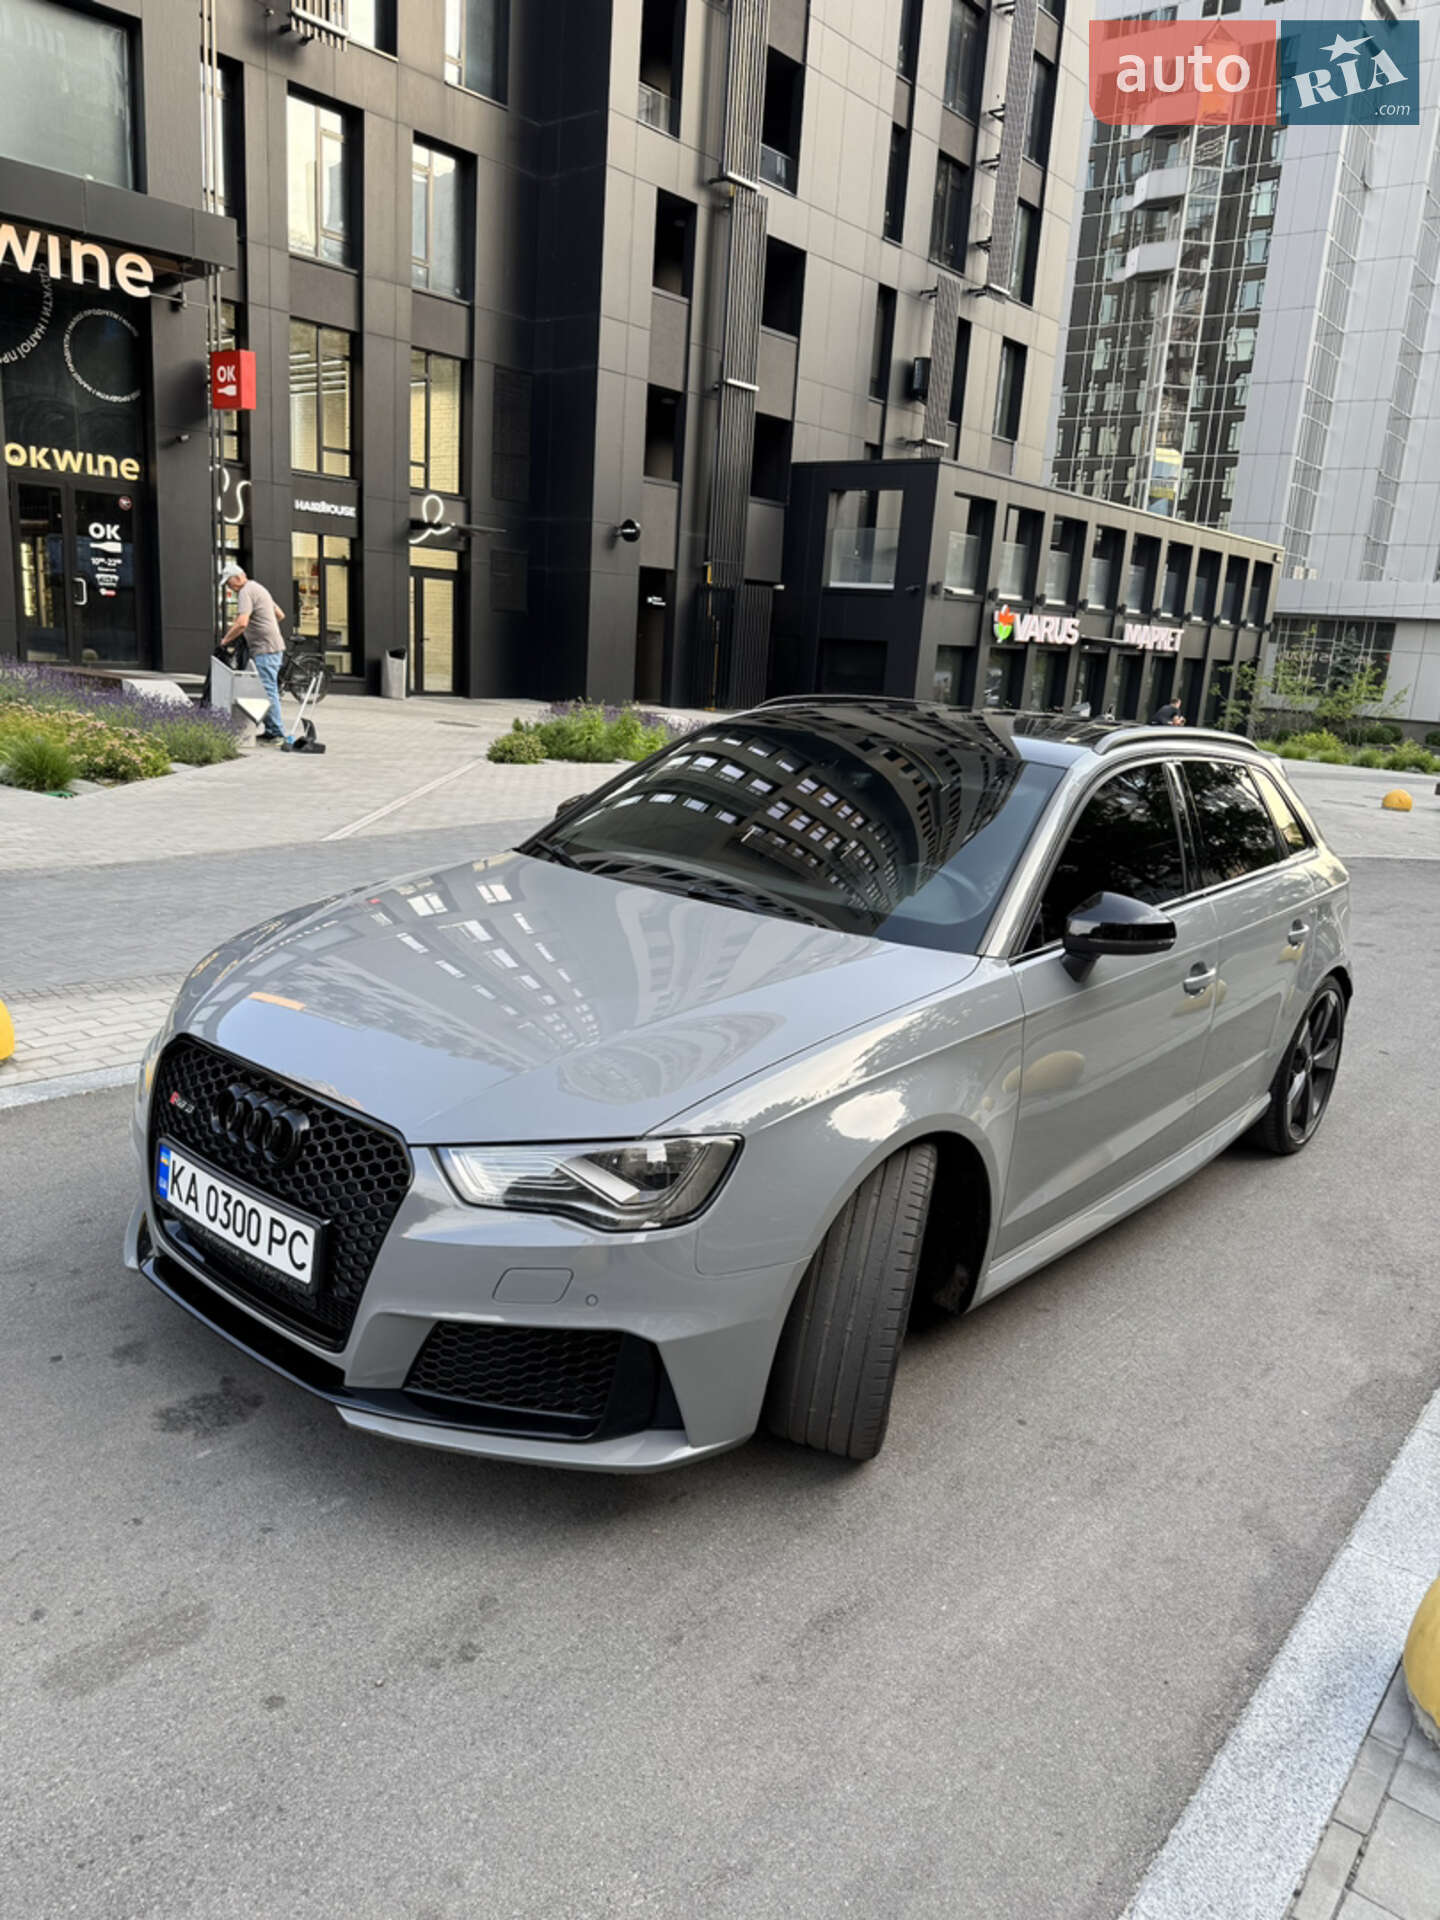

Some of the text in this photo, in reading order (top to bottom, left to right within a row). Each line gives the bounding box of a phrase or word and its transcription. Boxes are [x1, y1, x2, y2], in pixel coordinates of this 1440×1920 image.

[217, 365, 237, 383] OK
[88, 522, 122, 541] OK
[1013, 613, 1081, 645] VARUS
[169, 1160, 200, 1213] KA
[205, 1184, 262, 1247] 0300
[267, 1217, 309, 1272] PC
